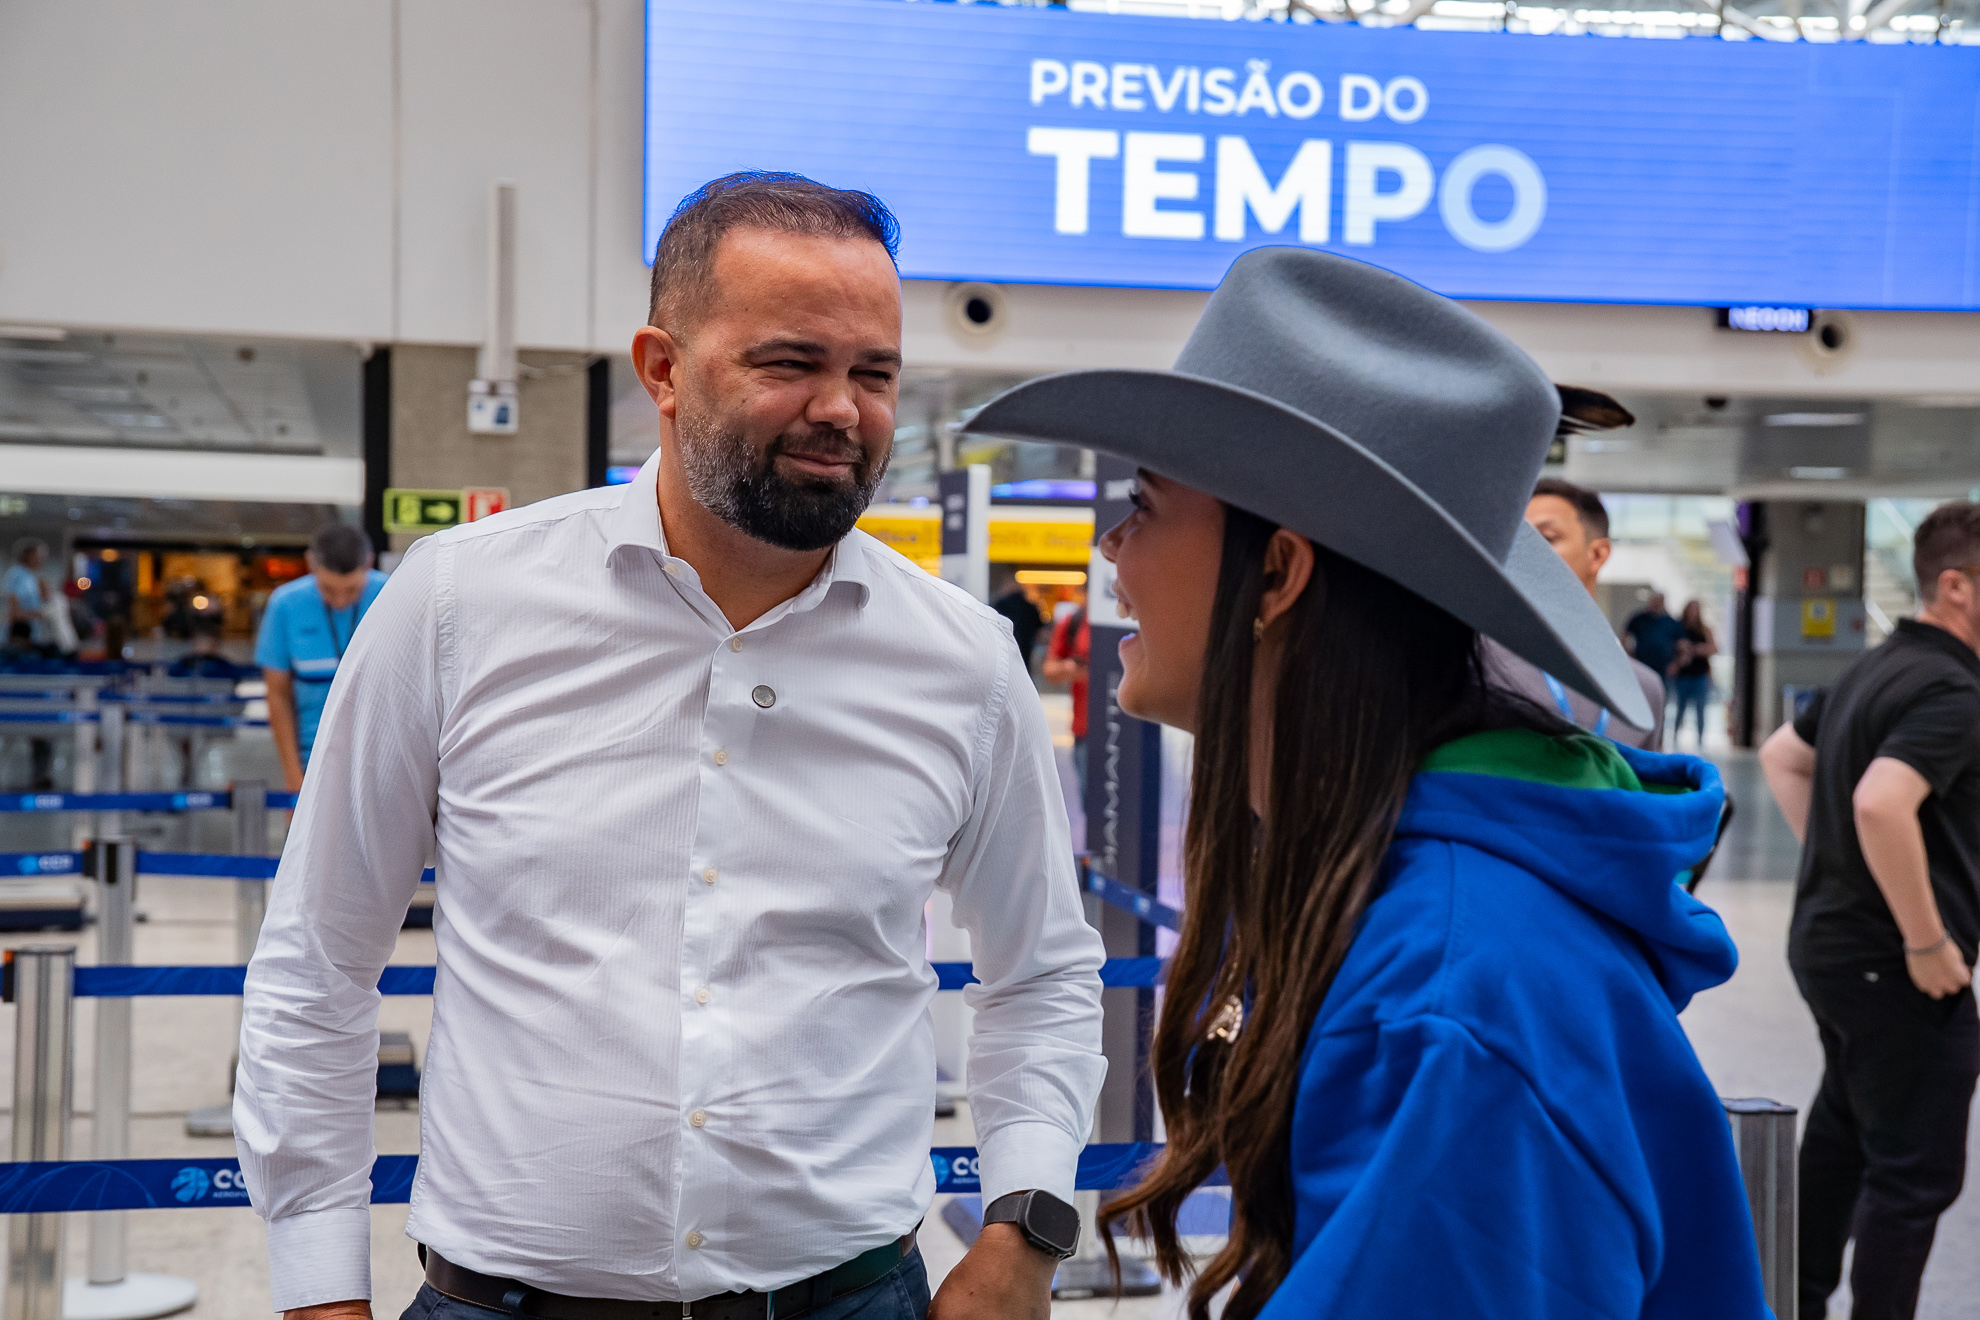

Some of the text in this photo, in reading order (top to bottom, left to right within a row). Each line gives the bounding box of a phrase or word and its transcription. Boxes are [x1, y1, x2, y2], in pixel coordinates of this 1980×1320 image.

[1030, 58, 1429, 124] PREVISÃO DO
[1027, 126, 1548, 253] TEMPO
